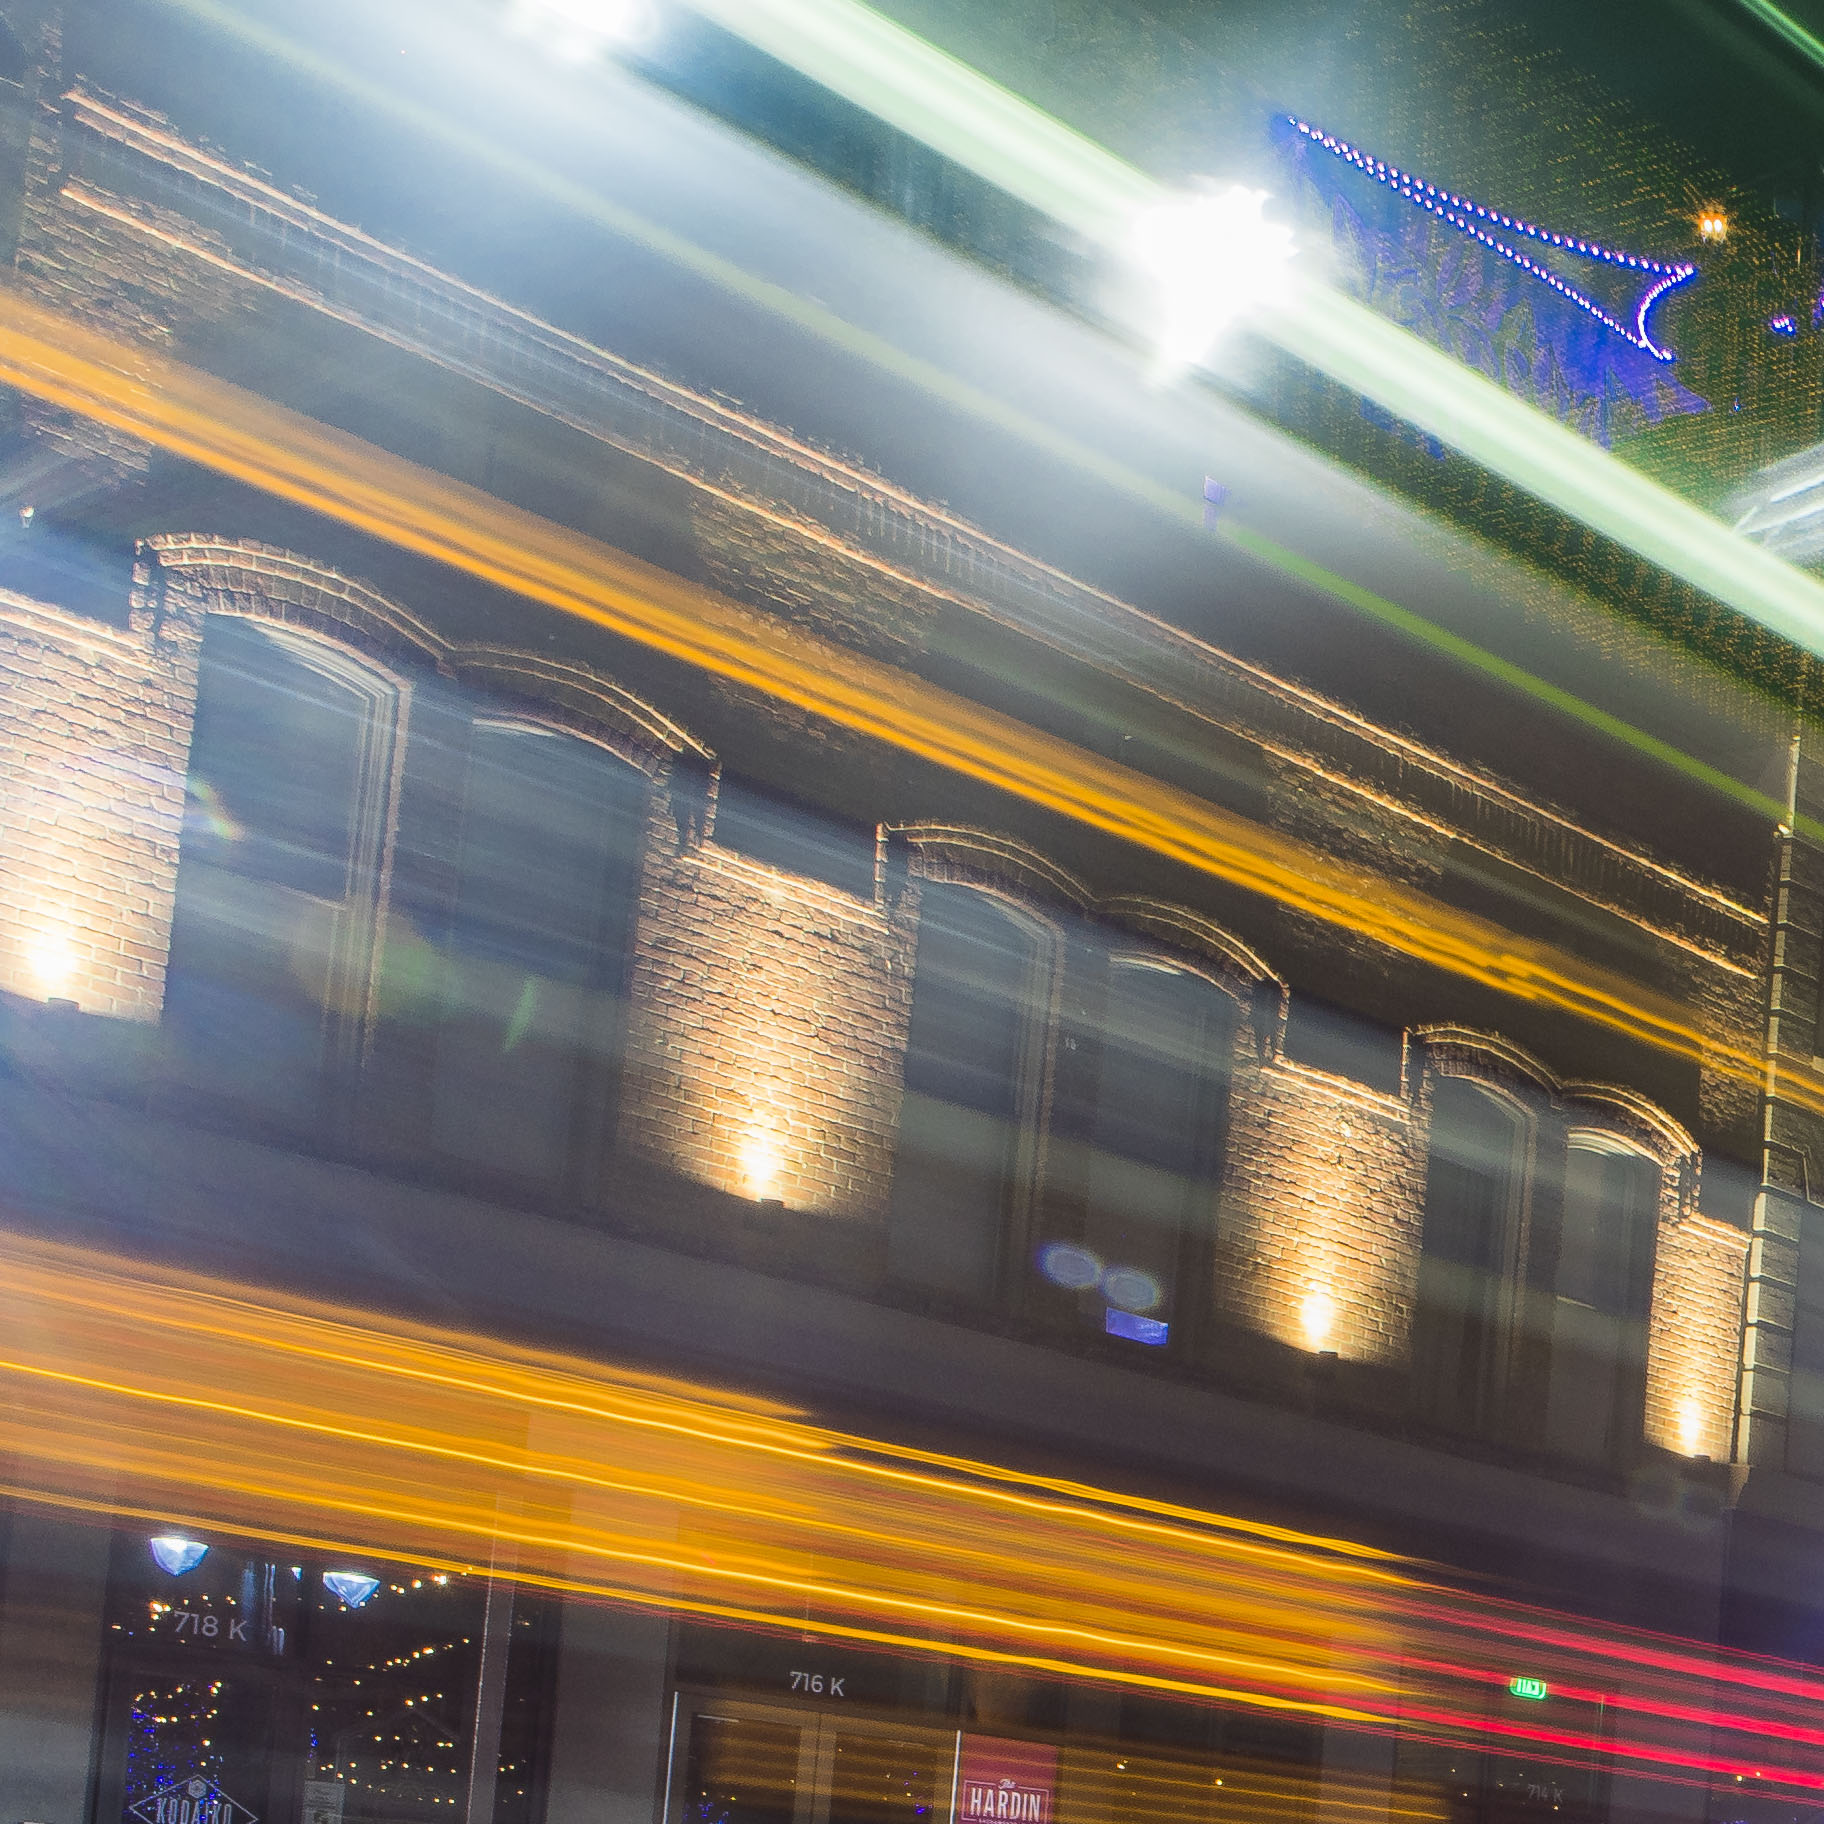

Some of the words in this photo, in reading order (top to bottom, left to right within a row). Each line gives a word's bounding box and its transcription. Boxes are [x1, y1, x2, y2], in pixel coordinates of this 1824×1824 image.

[174, 1610, 219, 1637] 718
[229, 1618, 248, 1642] K
[790, 1671, 823, 1693] 716
[831, 1677, 845, 1697] K
[970, 1787, 1041, 1823] HARDIN
